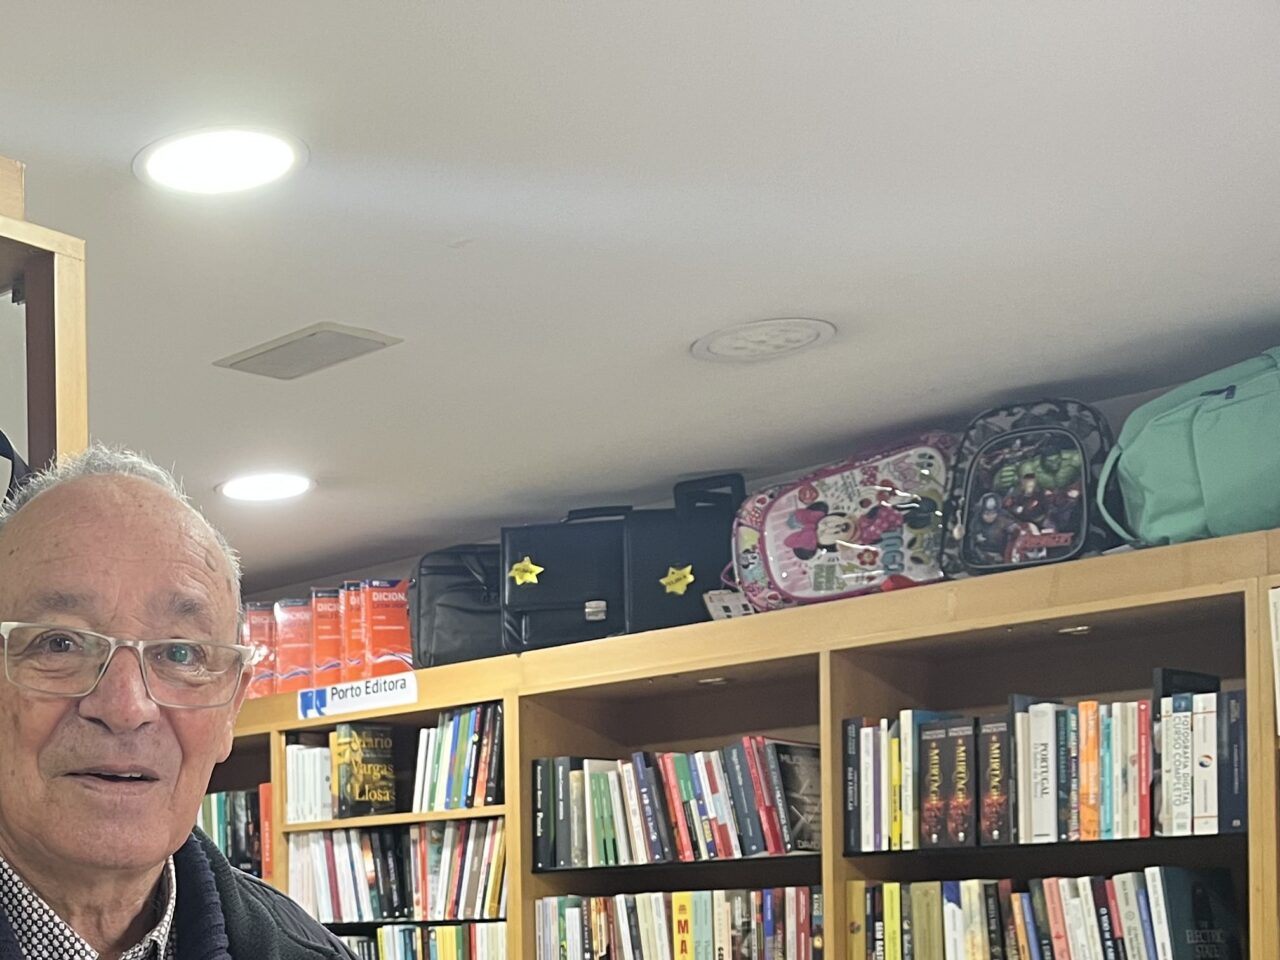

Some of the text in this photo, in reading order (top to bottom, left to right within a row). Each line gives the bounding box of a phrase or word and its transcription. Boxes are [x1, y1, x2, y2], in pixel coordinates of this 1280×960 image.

[372, 592, 406, 601] DICION
[330, 677, 408, 700] Porto Editora
[352, 757, 395, 779] Vargas
[928, 749, 941, 804] MURTAGH
[954, 746, 967, 802] MURTAGH
[989, 742, 1002, 799] MURTAGH
[1040, 742, 1049, 799] PORTUGAL
[1173, 715, 1182, 807] CURSO COMPLETO
[1182, 715, 1191, 806] FOTOGRAFIA DIGITAL
[354, 783, 391, 801] Llosa
[875, 921, 883, 939] SEM
